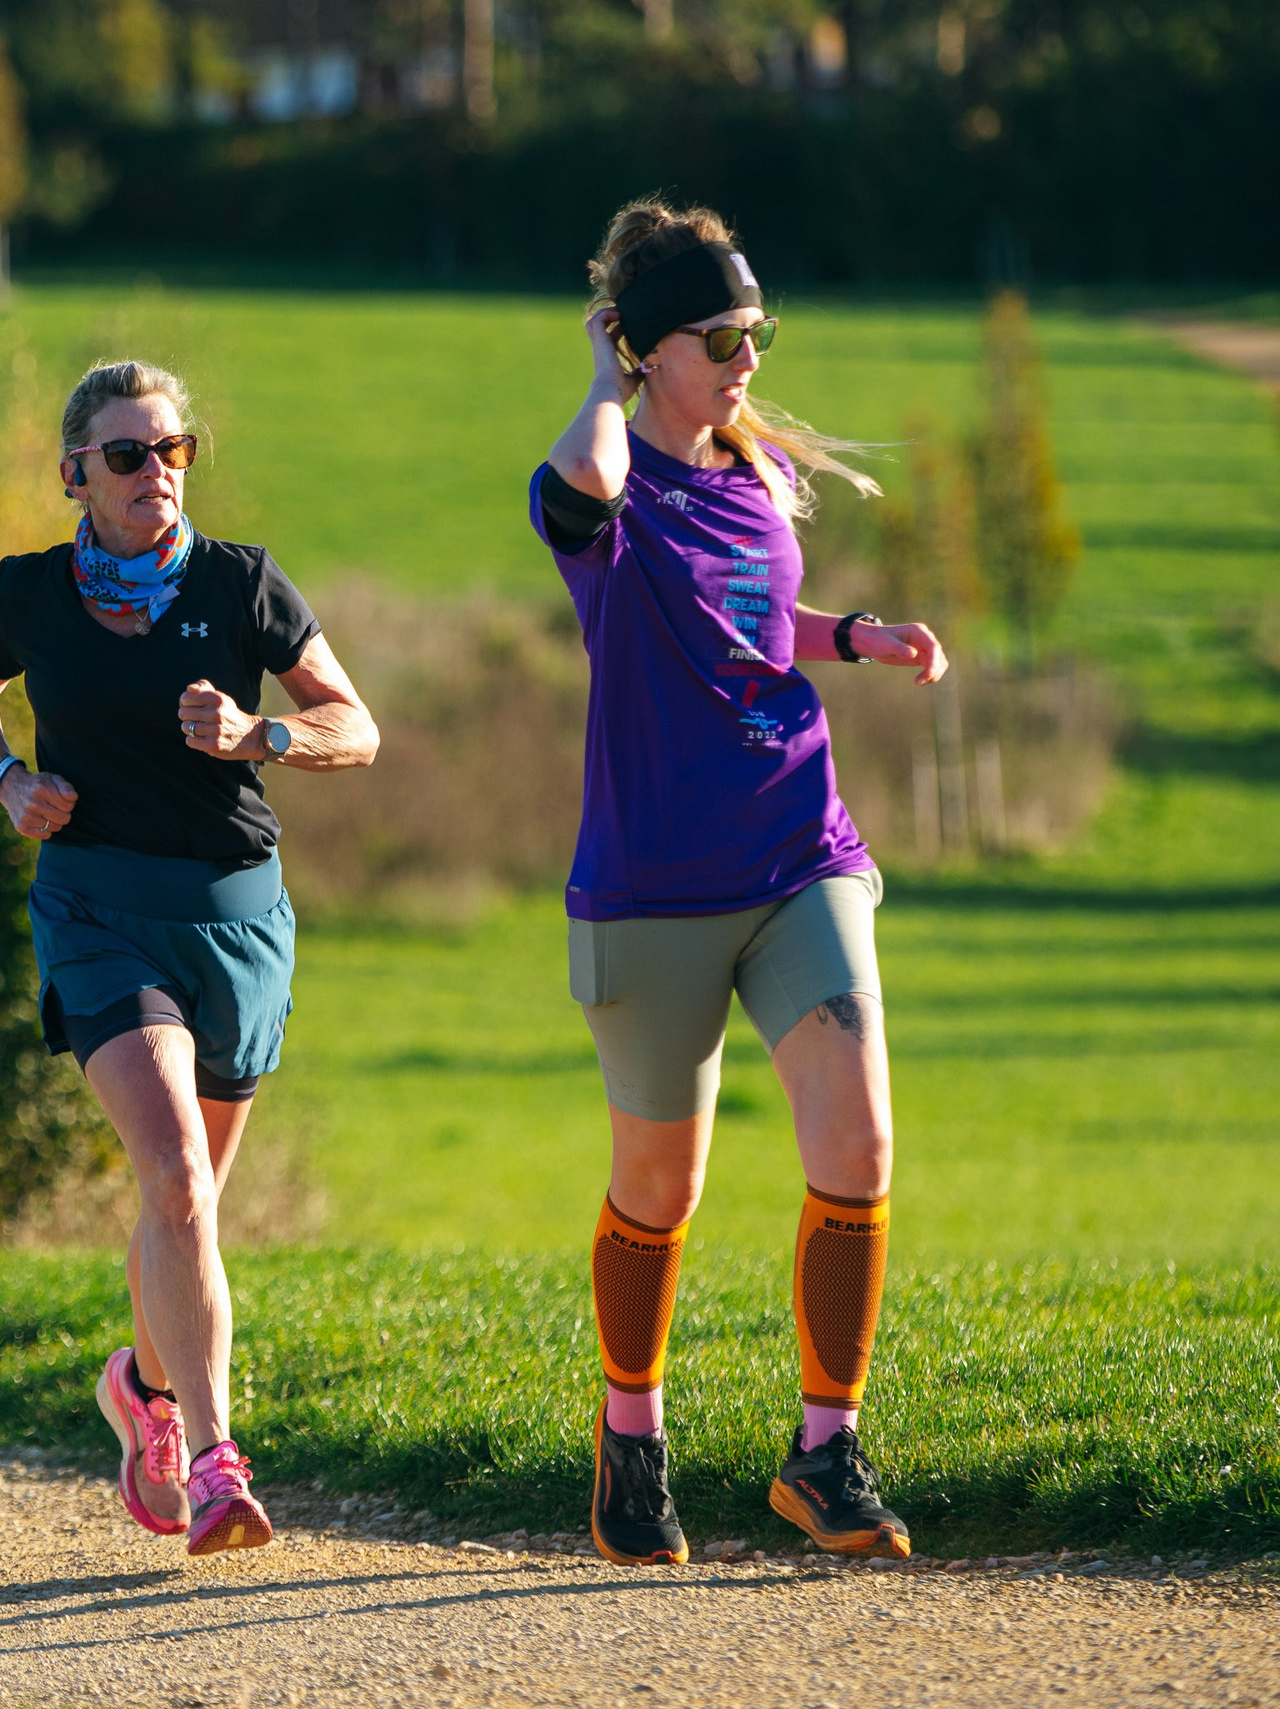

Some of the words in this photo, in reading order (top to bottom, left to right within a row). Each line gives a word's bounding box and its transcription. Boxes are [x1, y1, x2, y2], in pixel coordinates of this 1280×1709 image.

[730, 544, 768, 558] START
[732, 561, 769, 576] TRAIN
[728, 579, 771, 595] SWEAT
[724, 596, 770, 613] DREAM
[732, 615, 758, 630] WIN
[729, 648, 766, 661] FINIS
[748, 731, 777, 739] 2022
[795, 1479, 829, 1510] ALTRA
